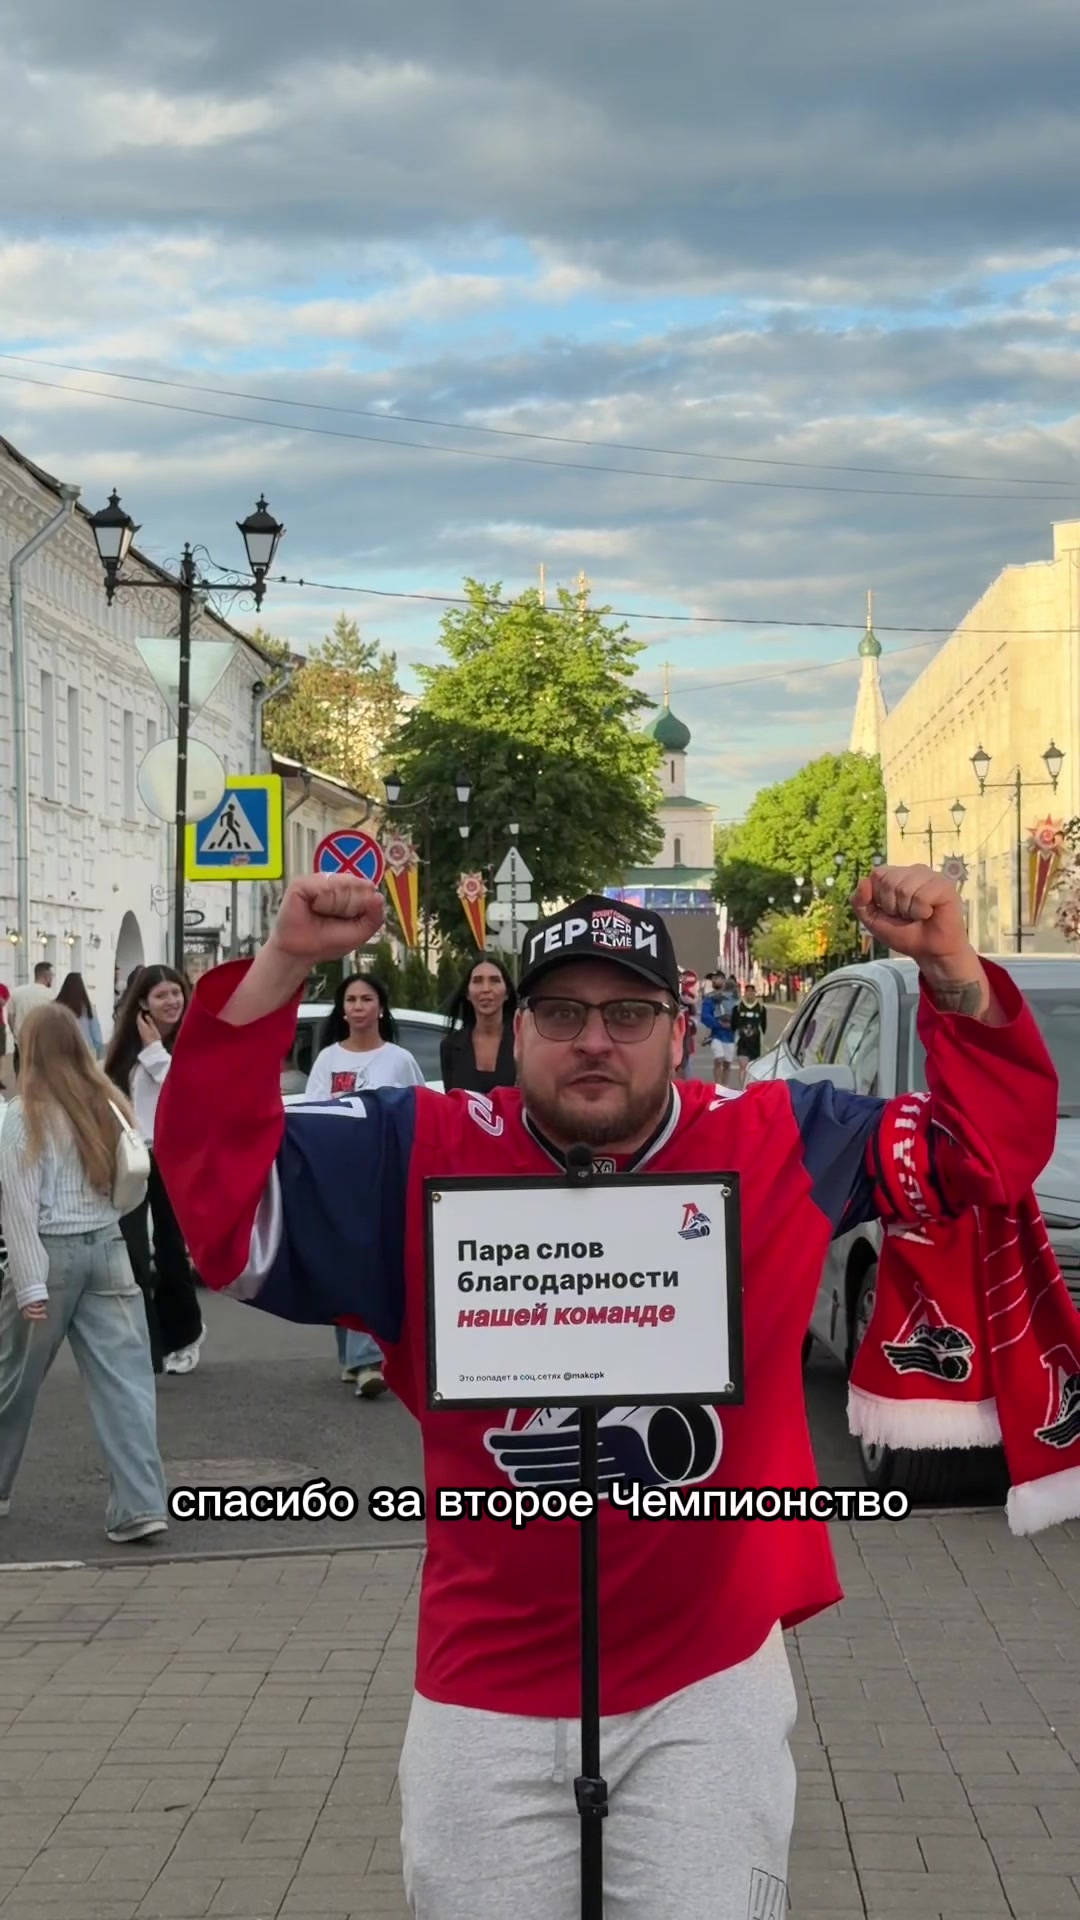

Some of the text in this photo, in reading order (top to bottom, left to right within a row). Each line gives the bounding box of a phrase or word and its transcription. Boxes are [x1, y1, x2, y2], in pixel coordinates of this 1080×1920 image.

[591, 916, 632, 935] OVER
[591, 931, 632, 947] TIME
[458, 1240, 605, 1266] Пара слов
[457, 1270, 679, 1296] благодарности
[457, 1302, 676, 1328] нашей команде
[459, 1374, 475, 1382] Это
[476, 1374, 511, 1383] попадет
[520, 1373, 561, 1382] соц.сетях
[563, 1371, 605, 1382] @makcpk
